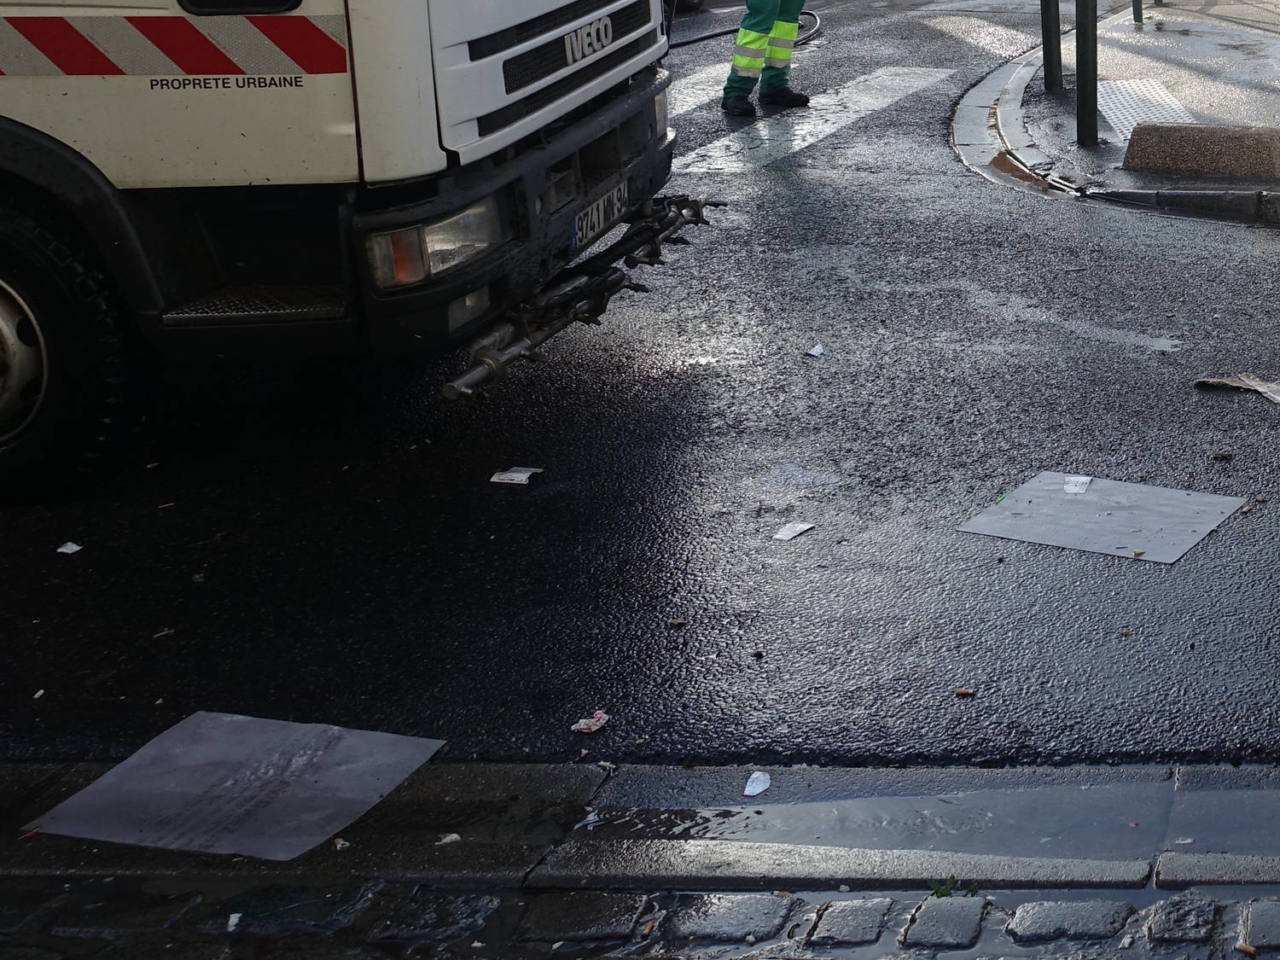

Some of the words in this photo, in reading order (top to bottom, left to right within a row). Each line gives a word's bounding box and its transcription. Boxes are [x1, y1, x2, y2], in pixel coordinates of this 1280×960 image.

[564, 16, 613, 65] IVECO
[150, 78, 231, 90] PROPRETE
[236, 76, 304, 89] URBAINE
